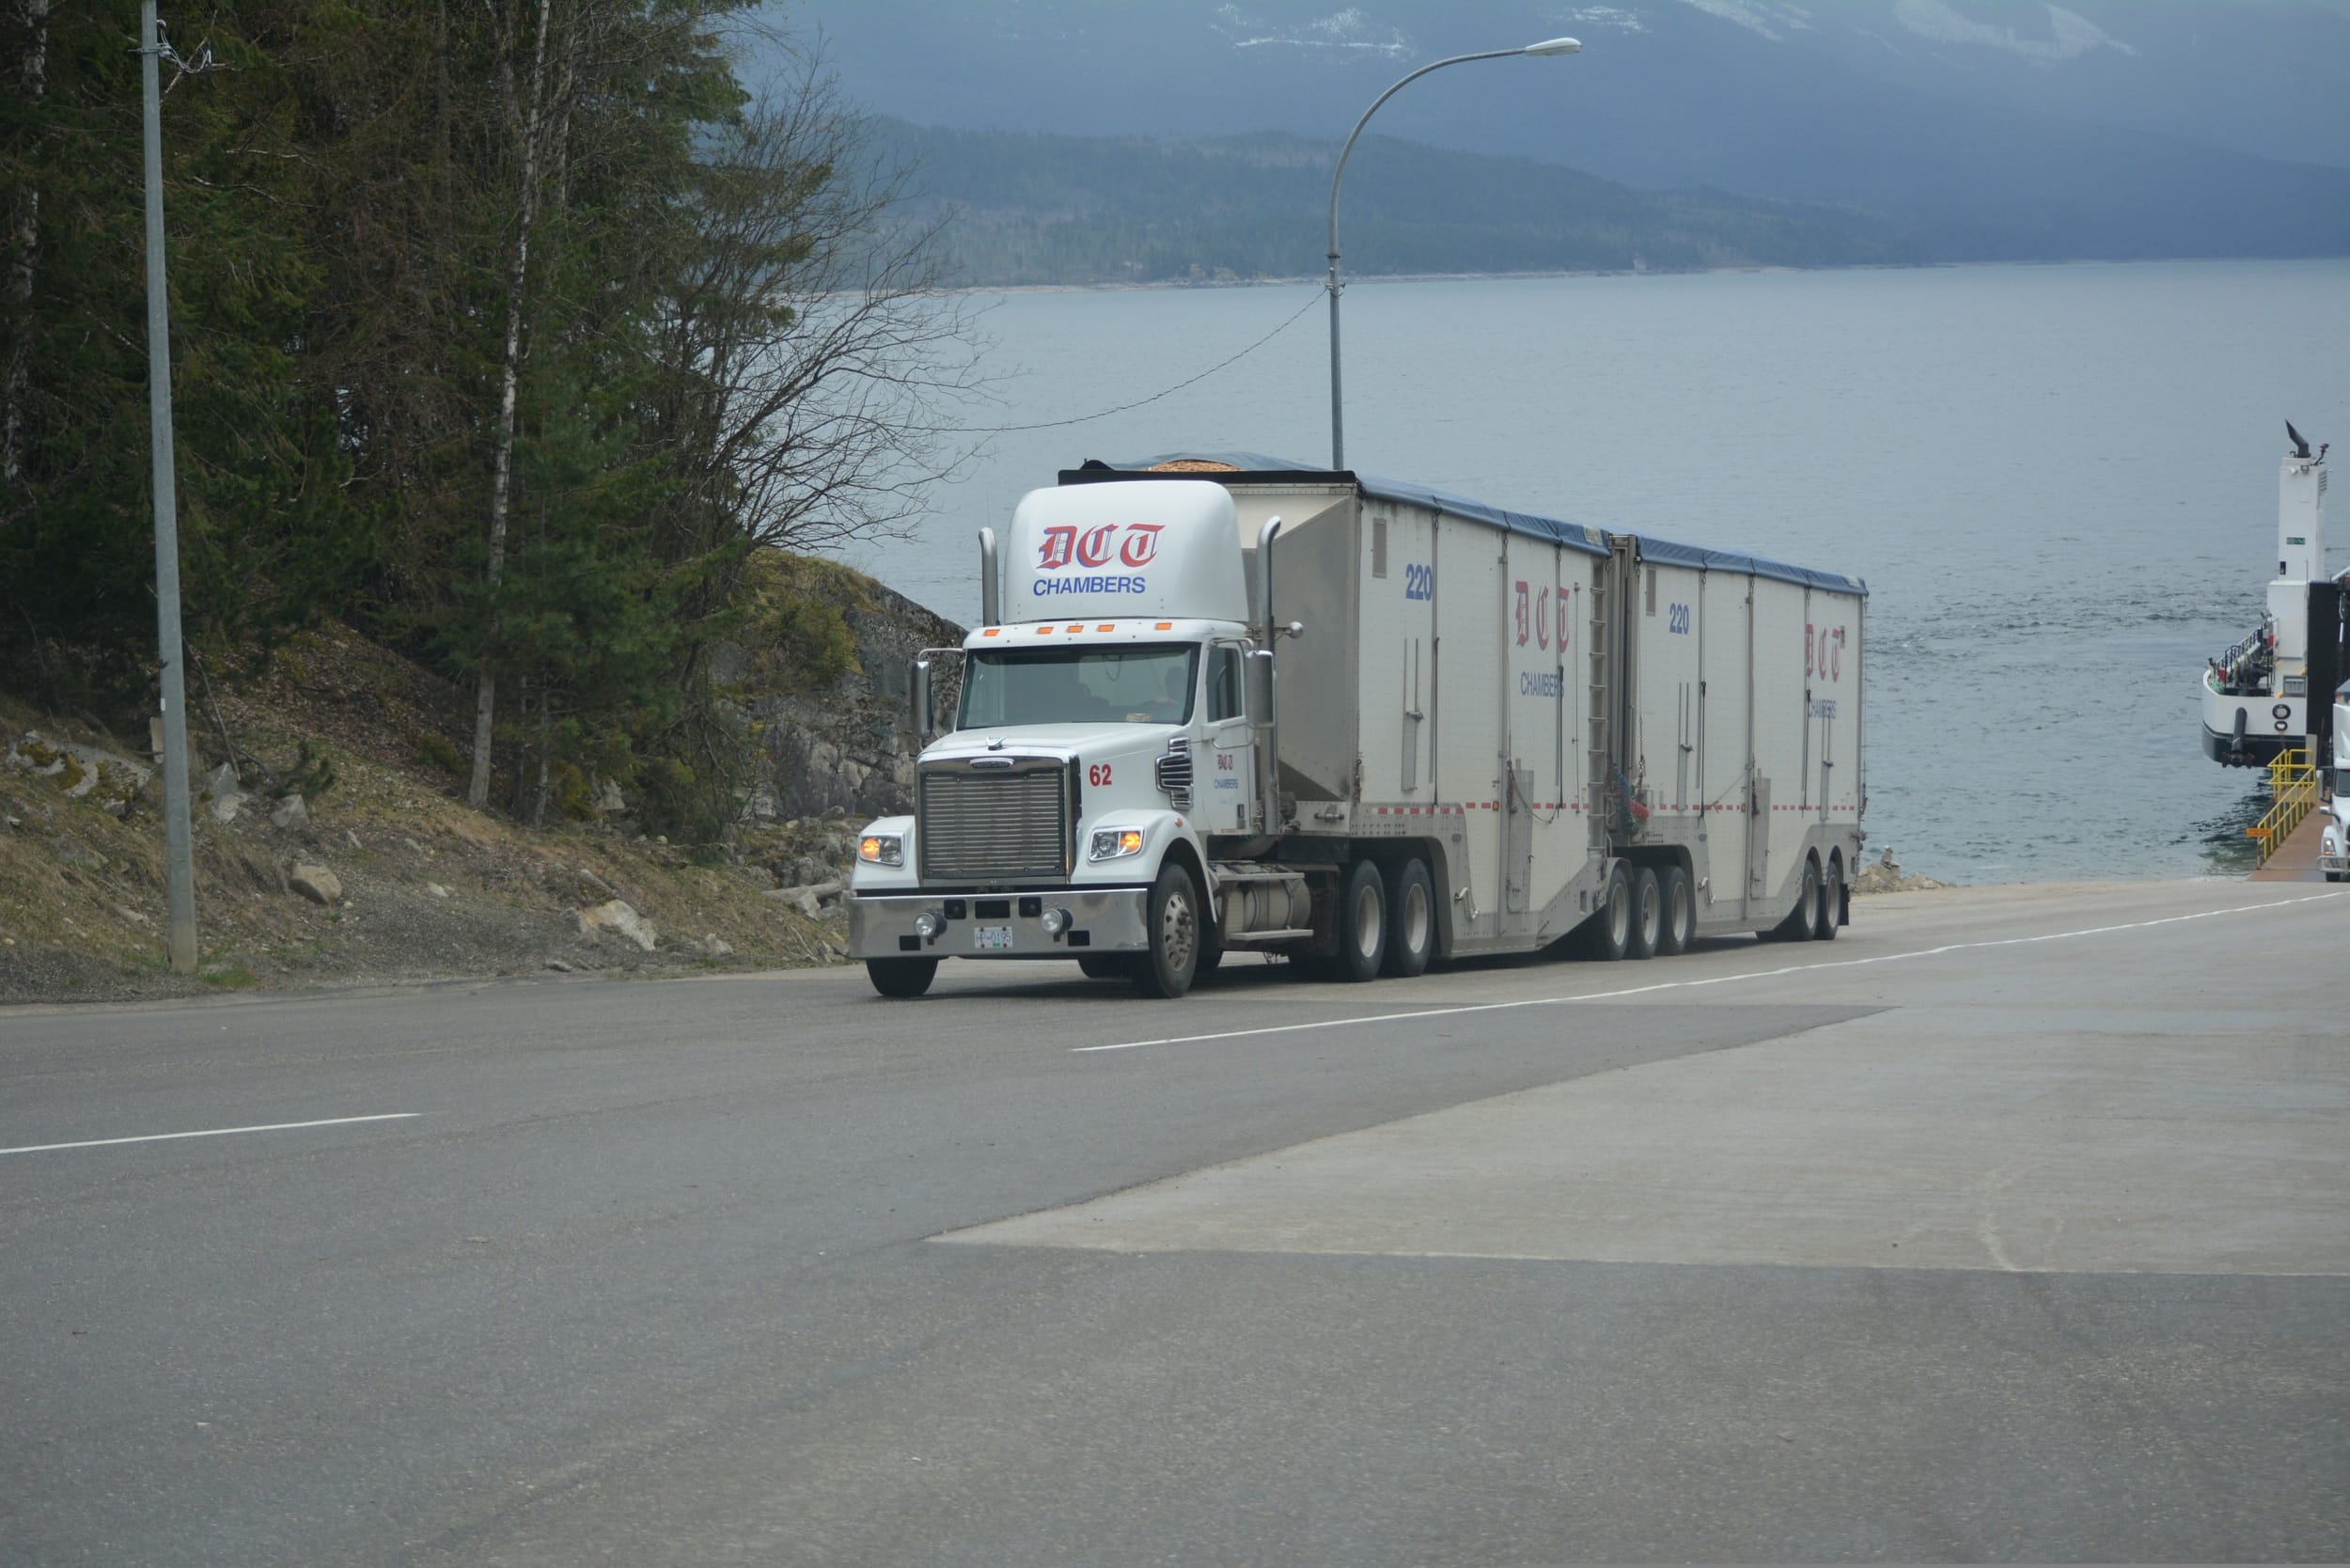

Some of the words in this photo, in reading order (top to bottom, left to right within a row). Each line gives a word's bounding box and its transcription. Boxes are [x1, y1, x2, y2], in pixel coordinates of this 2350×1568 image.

[1036, 524, 1166, 570] DCT
[1034, 576, 1146, 596] CHAMBERS
[1405, 563, 1433, 602] 220
[1515, 580, 1570, 653] DCT
[1668, 602, 1689, 635] 220
[1089, 763, 1112, 787] 62
